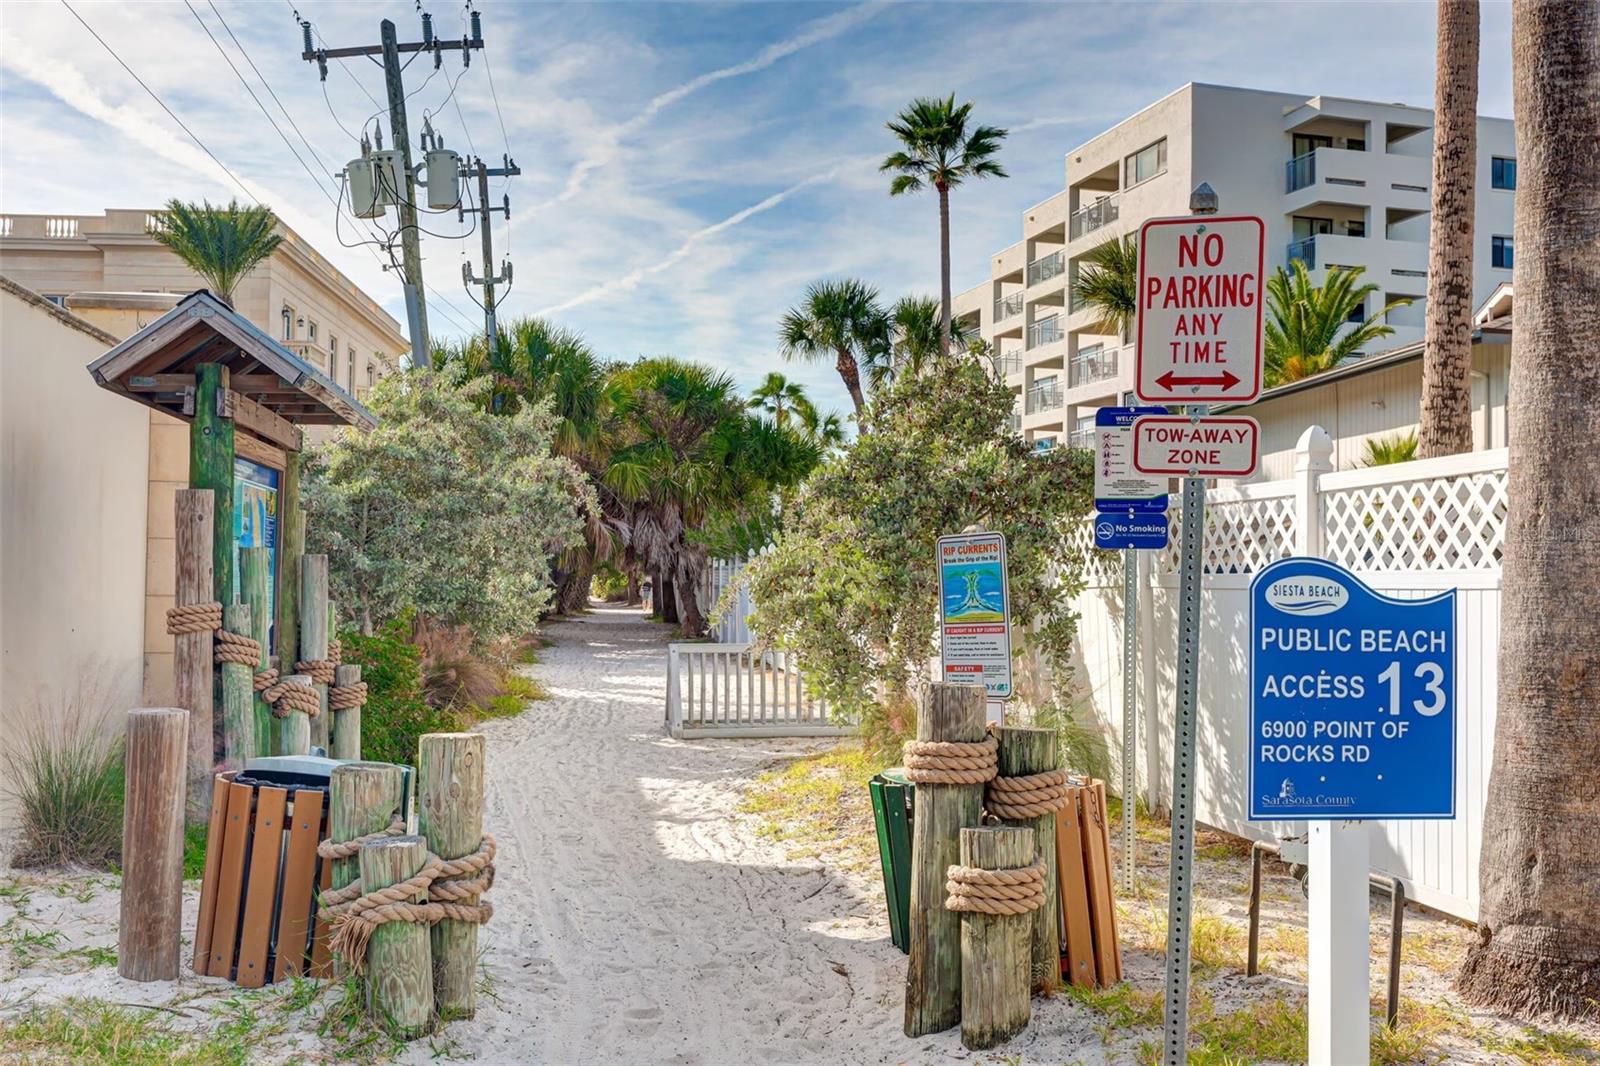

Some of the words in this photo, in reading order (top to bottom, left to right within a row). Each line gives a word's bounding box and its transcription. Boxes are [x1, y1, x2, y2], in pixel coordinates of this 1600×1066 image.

[1178, 233, 1224, 268] NO
[1147, 273, 1255, 310] PARKING
[1175, 313, 1223, 336] ANY
[1169, 340, 1227, 364] TIME
[1145, 428, 1249, 444] TOW-AWAY
[1167, 449, 1221, 465] ZONE
[1129, 525, 1166, 534] Smoking
[943, 546, 956, 555] RIP
[958, 543, 998, 555] CURRENTS
[1273, 584, 1305, 597] SIESTA
[1308, 585, 1341, 598] BEACH
[1261, 628, 1352, 652] PUBLIC
[1360, 629, 1446, 653] BEACH
[1262, 674, 1365, 699] ACCESS
[1377, 661, 1447, 717] 13
[1261, 721, 1307, 739] 6900
[1313, 721, 1376, 739] POINT
[1381, 721, 1410, 739] OF
[1261, 744, 1335, 763] ROCKS
[1341, 744, 1370, 763] RD
[1261, 794, 1313, 805] Sarasota
[1316, 794, 1357, 806] County
